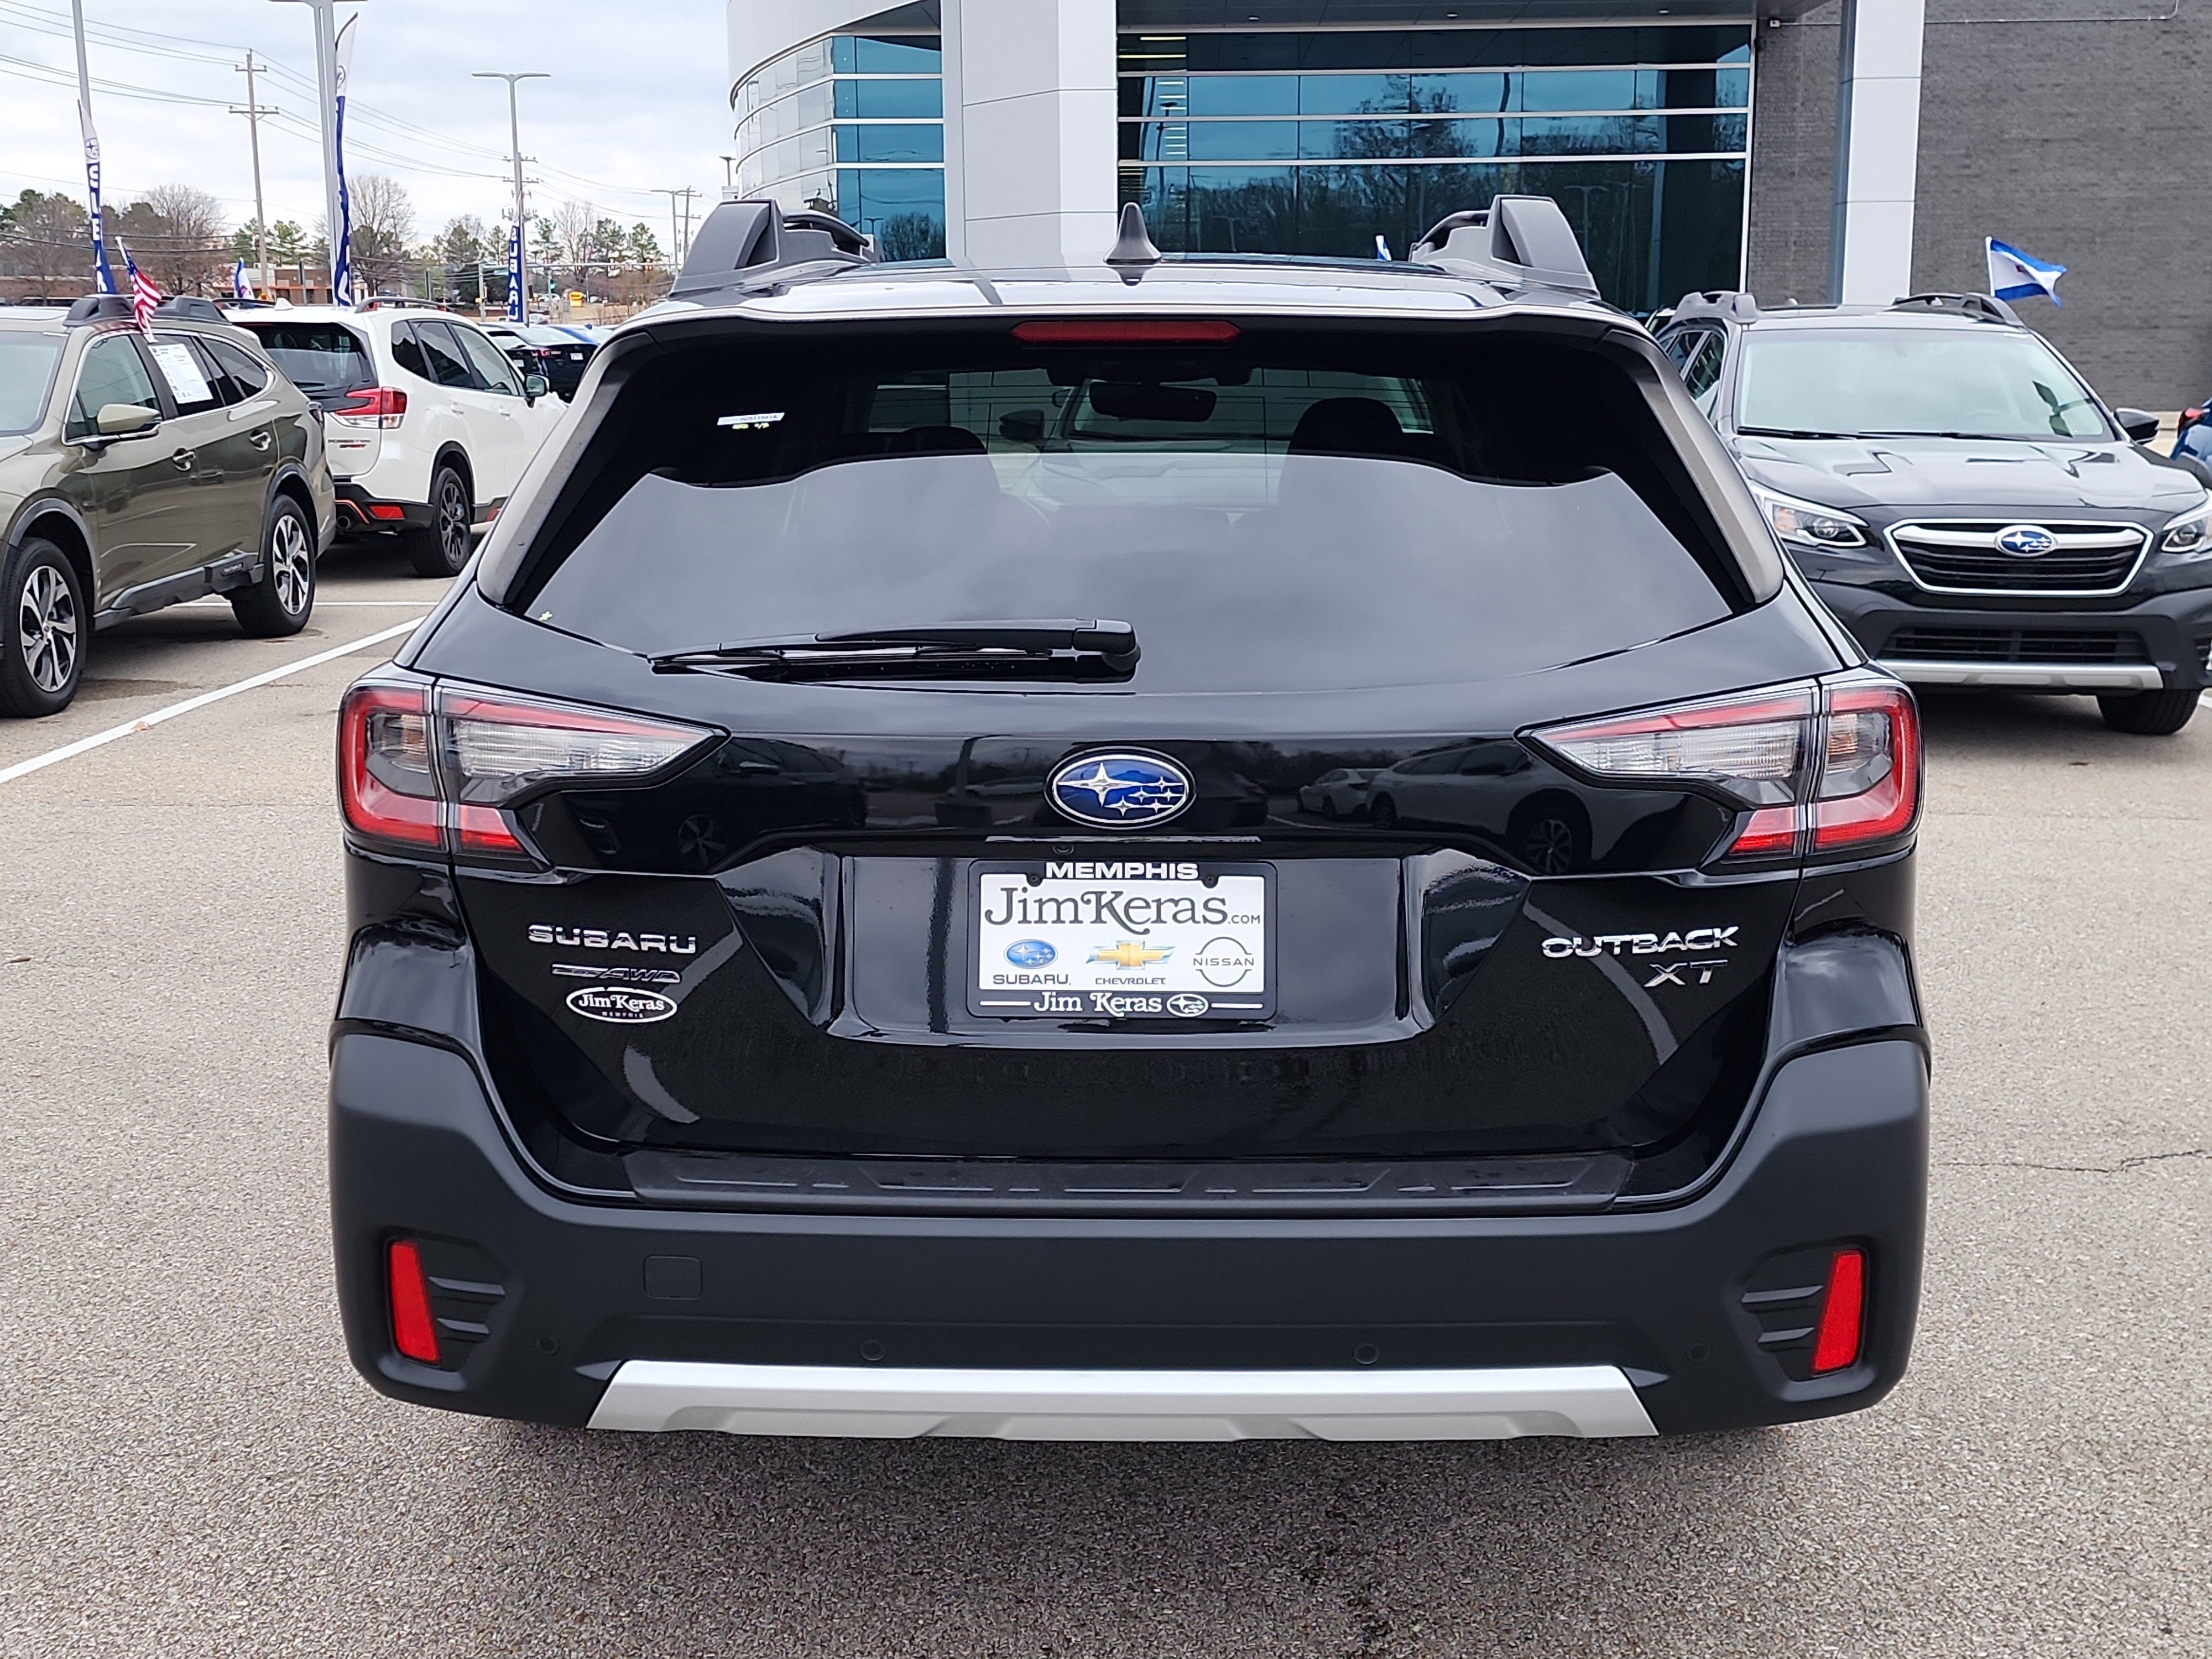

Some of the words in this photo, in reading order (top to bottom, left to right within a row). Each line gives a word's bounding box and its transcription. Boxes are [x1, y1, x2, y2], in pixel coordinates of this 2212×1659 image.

[1046, 862, 1199, 879] MEMPHIS
[528, 924, 696, 953] SUBARU
[1541, 926, 1739, 958] OUTBACK
[1193, 957, 1254, 967] NISSAN
[1643, 959, 1728, 987] XT
[993, 974, 1070, 985] SUBARU
[1034, 992, 1083, 1011] Jim
[1090, 993, 1162, 1017] Keras
